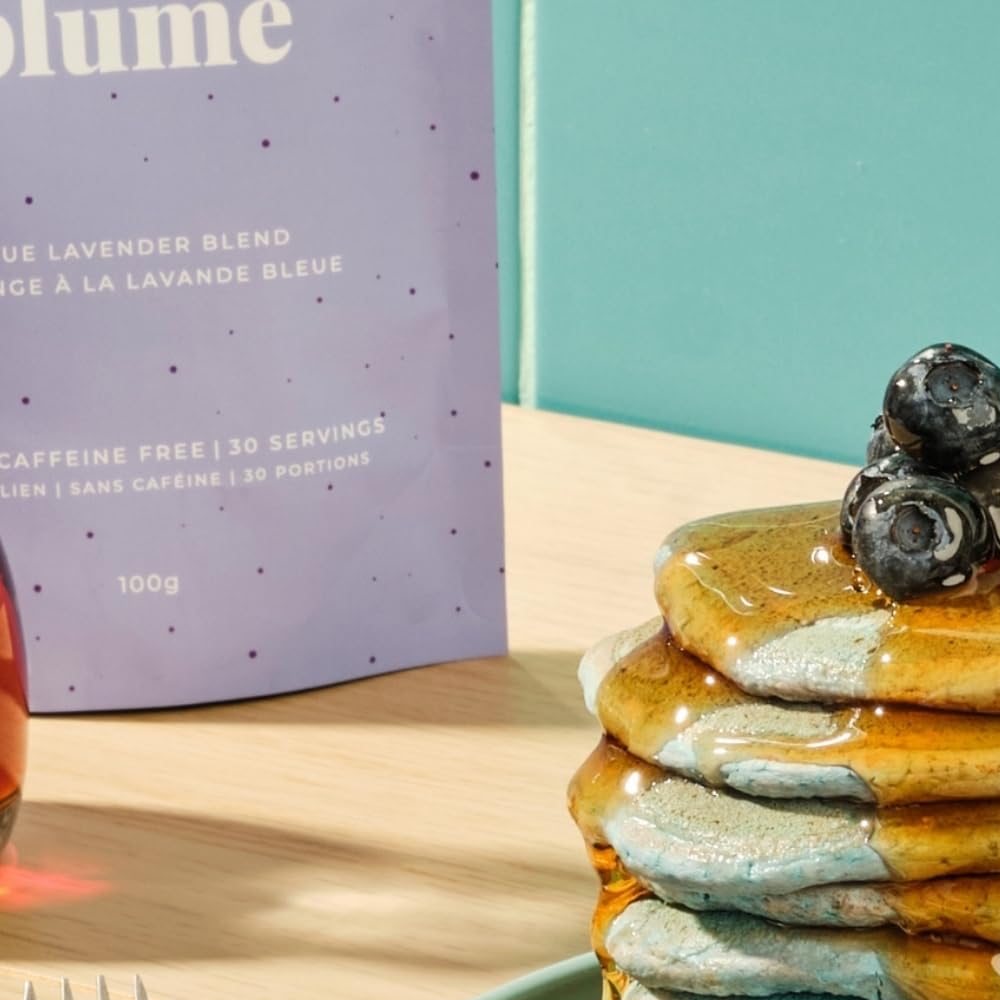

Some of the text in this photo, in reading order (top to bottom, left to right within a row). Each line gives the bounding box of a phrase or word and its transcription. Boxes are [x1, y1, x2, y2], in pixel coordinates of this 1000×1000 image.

[49, 236, 189, 260] LAVENDER
[203, 229, 290, 251] BLEND
[56, 274, 71, 293] À
[84, 275, 114, 292] LA
[127, 265, 249, 289] LAVANDE
[263, 256, 342, 280] BLEUE
[0, 448, 126, 468] CAFFEINE
[140, 442, 204, 462] FREE
[229, 437, 257, 455] 30
[270, 417, 385, 451] SERVINGS
[70, 480, 123, 495] SANS
[132, 472, 220, 491] CAFÉINE
[244, 467, 266, 482] 30
[275, 452, 370, 479] PORTIONS
[118, 574, 178, 594] 100g
